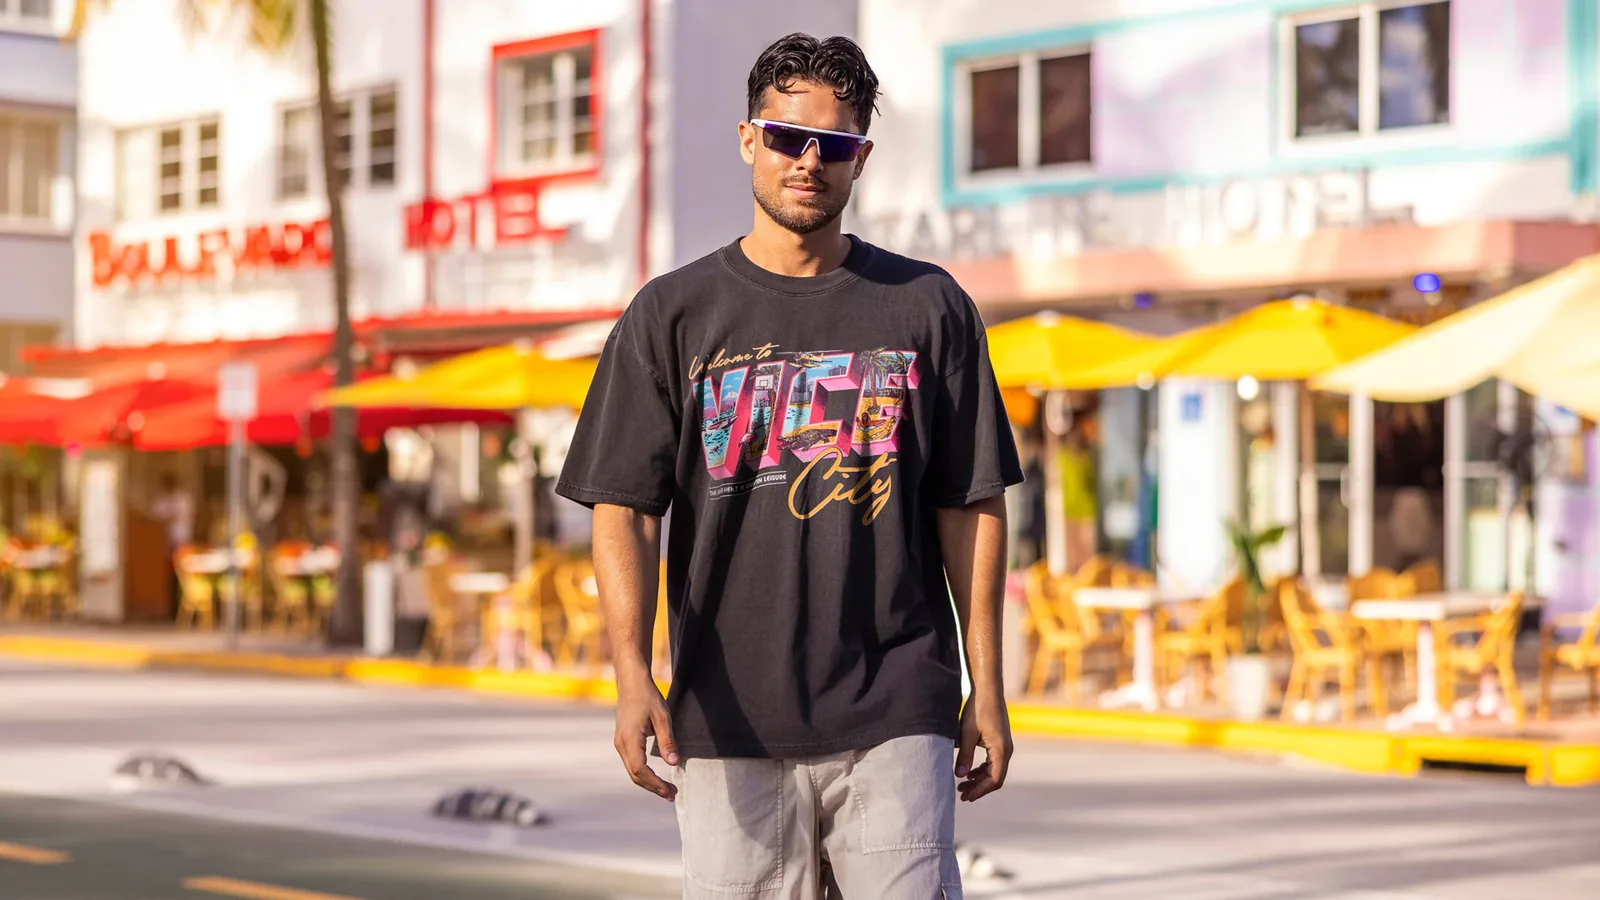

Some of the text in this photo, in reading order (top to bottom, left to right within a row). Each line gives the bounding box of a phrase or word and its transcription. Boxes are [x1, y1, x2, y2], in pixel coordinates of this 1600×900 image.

[688, 342, 780, 380] Welcome to
[691, 348, 920, 480] VICE
[763, 473, 787, 482] LEISURE
[788, 446, 898, 526] City
